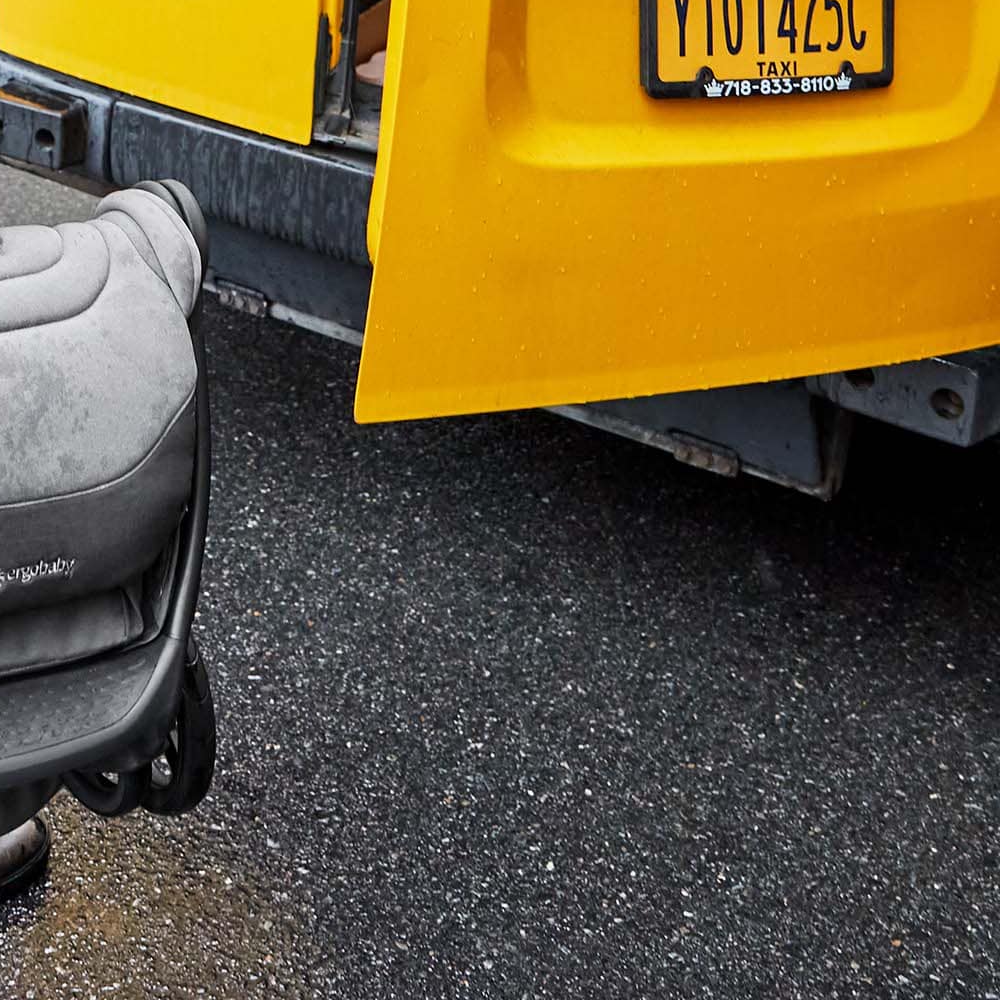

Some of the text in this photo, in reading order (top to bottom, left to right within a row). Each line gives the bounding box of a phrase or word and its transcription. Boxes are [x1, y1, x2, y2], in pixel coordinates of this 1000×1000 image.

[756, 61, 798, 77] TAXI
[723, 75, 835, 97] 718-833-8110
[7, 557, 76, 583] ergobaby
